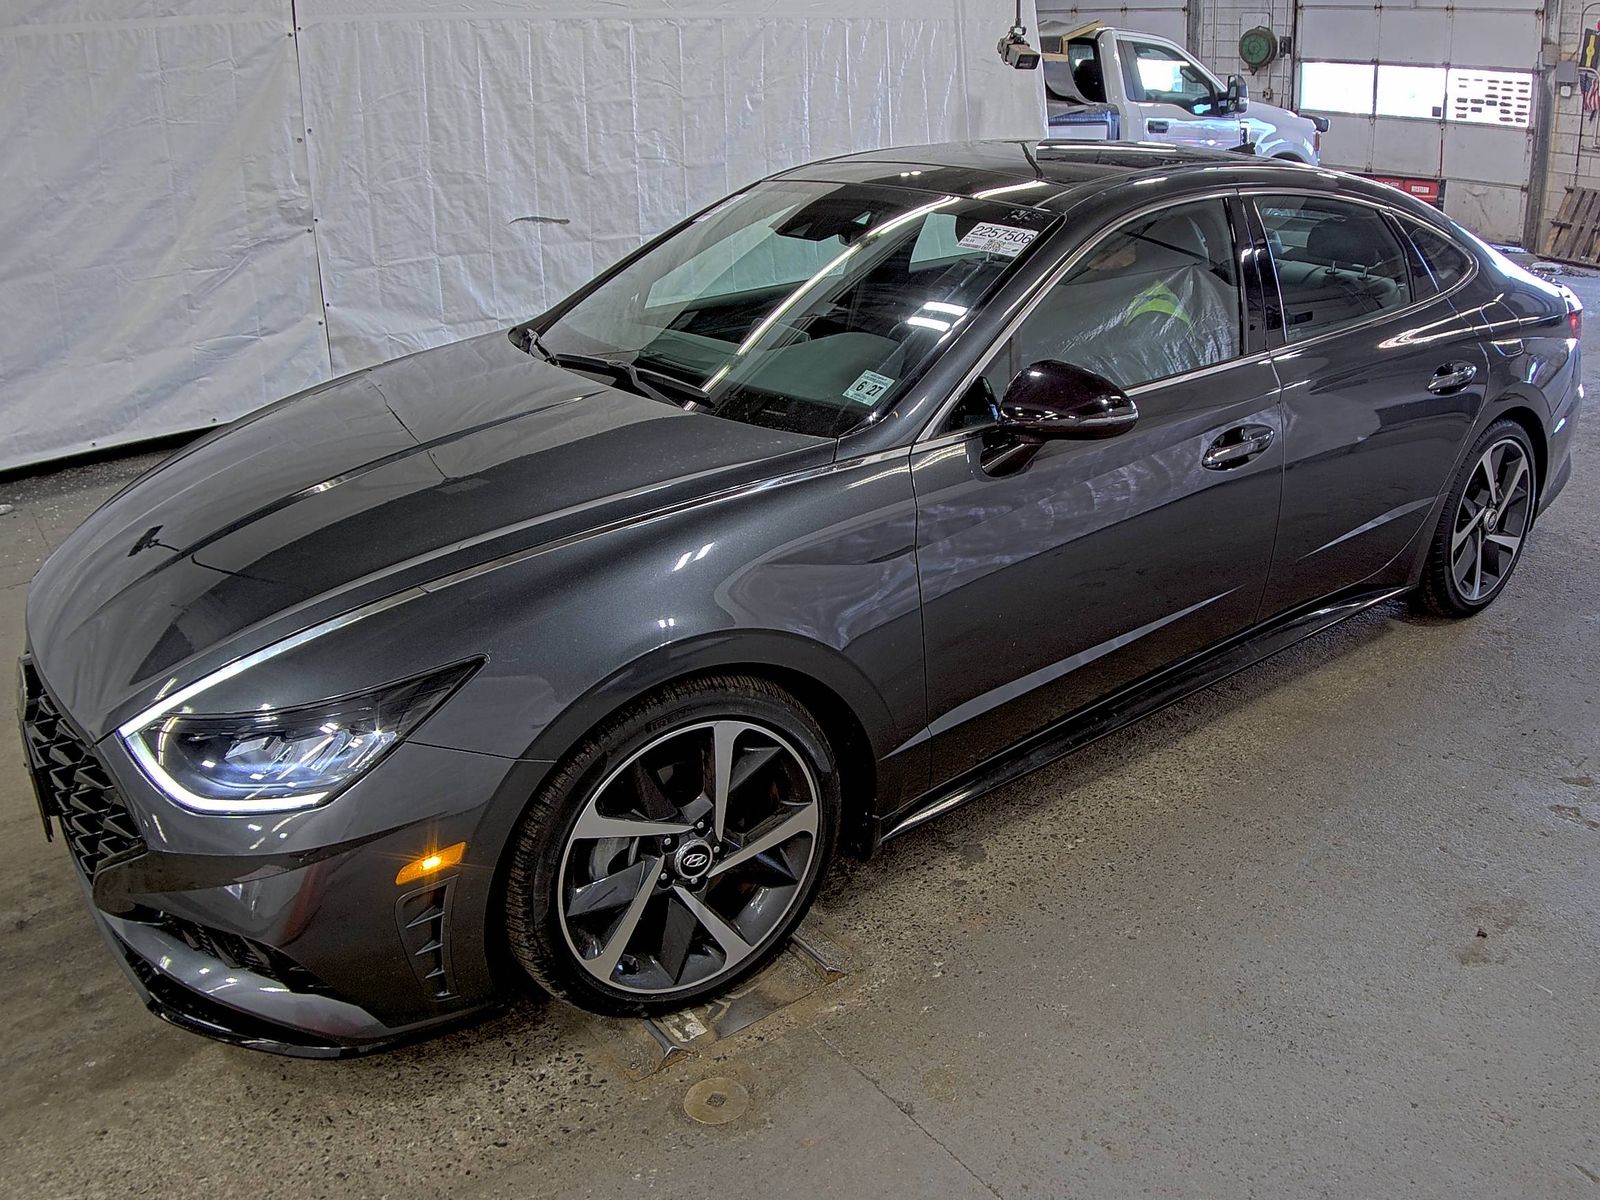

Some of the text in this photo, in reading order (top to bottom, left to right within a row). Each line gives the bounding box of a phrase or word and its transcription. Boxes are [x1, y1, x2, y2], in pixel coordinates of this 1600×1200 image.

[971, 225, 1035, 244] 2257506
[856, 381, 868, 391] 6
[866, 384, 884, 397] 27
